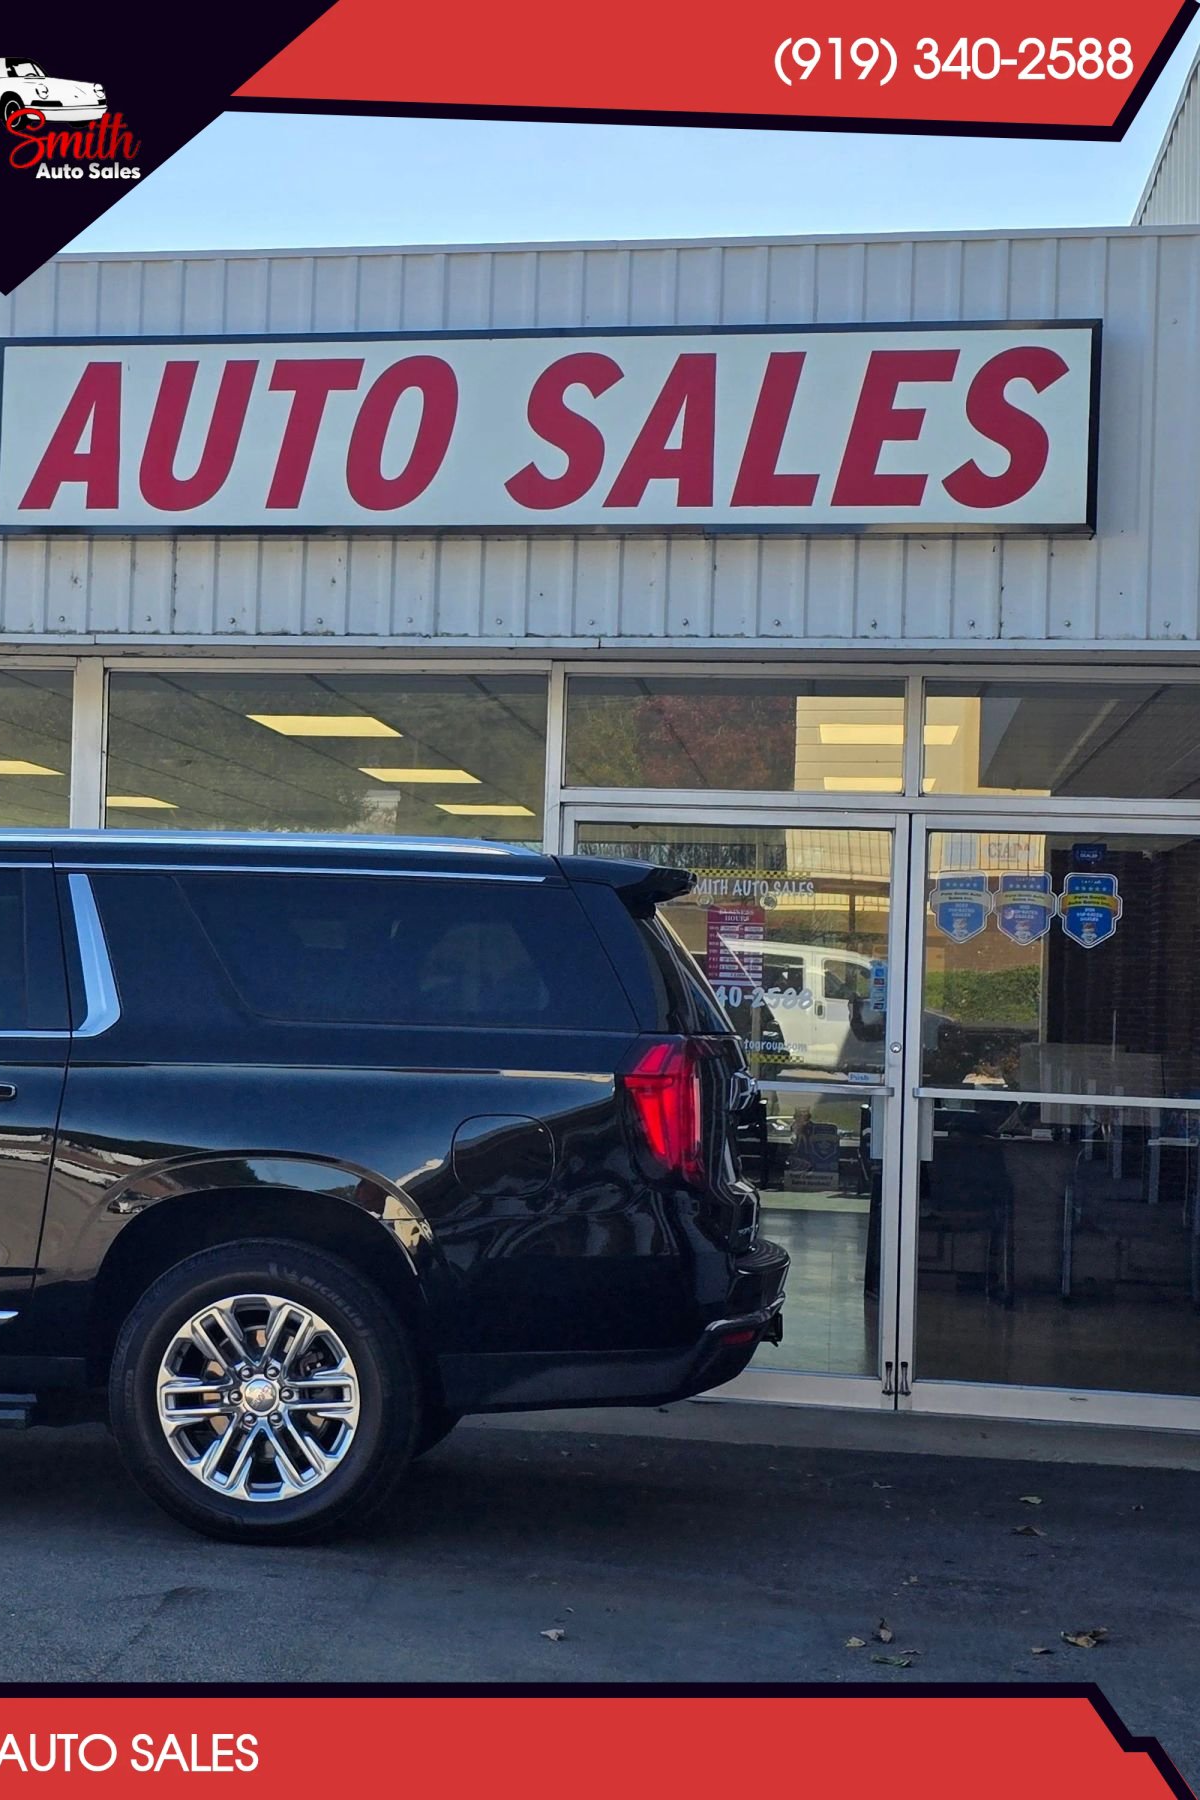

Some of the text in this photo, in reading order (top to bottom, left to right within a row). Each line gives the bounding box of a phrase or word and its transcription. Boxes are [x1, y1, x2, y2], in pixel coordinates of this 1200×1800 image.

[22, 348, 1065, 511] AUTO SALES
[732, 879, 769, 897] AUTO
[773, 881, 814, 897] SALES
